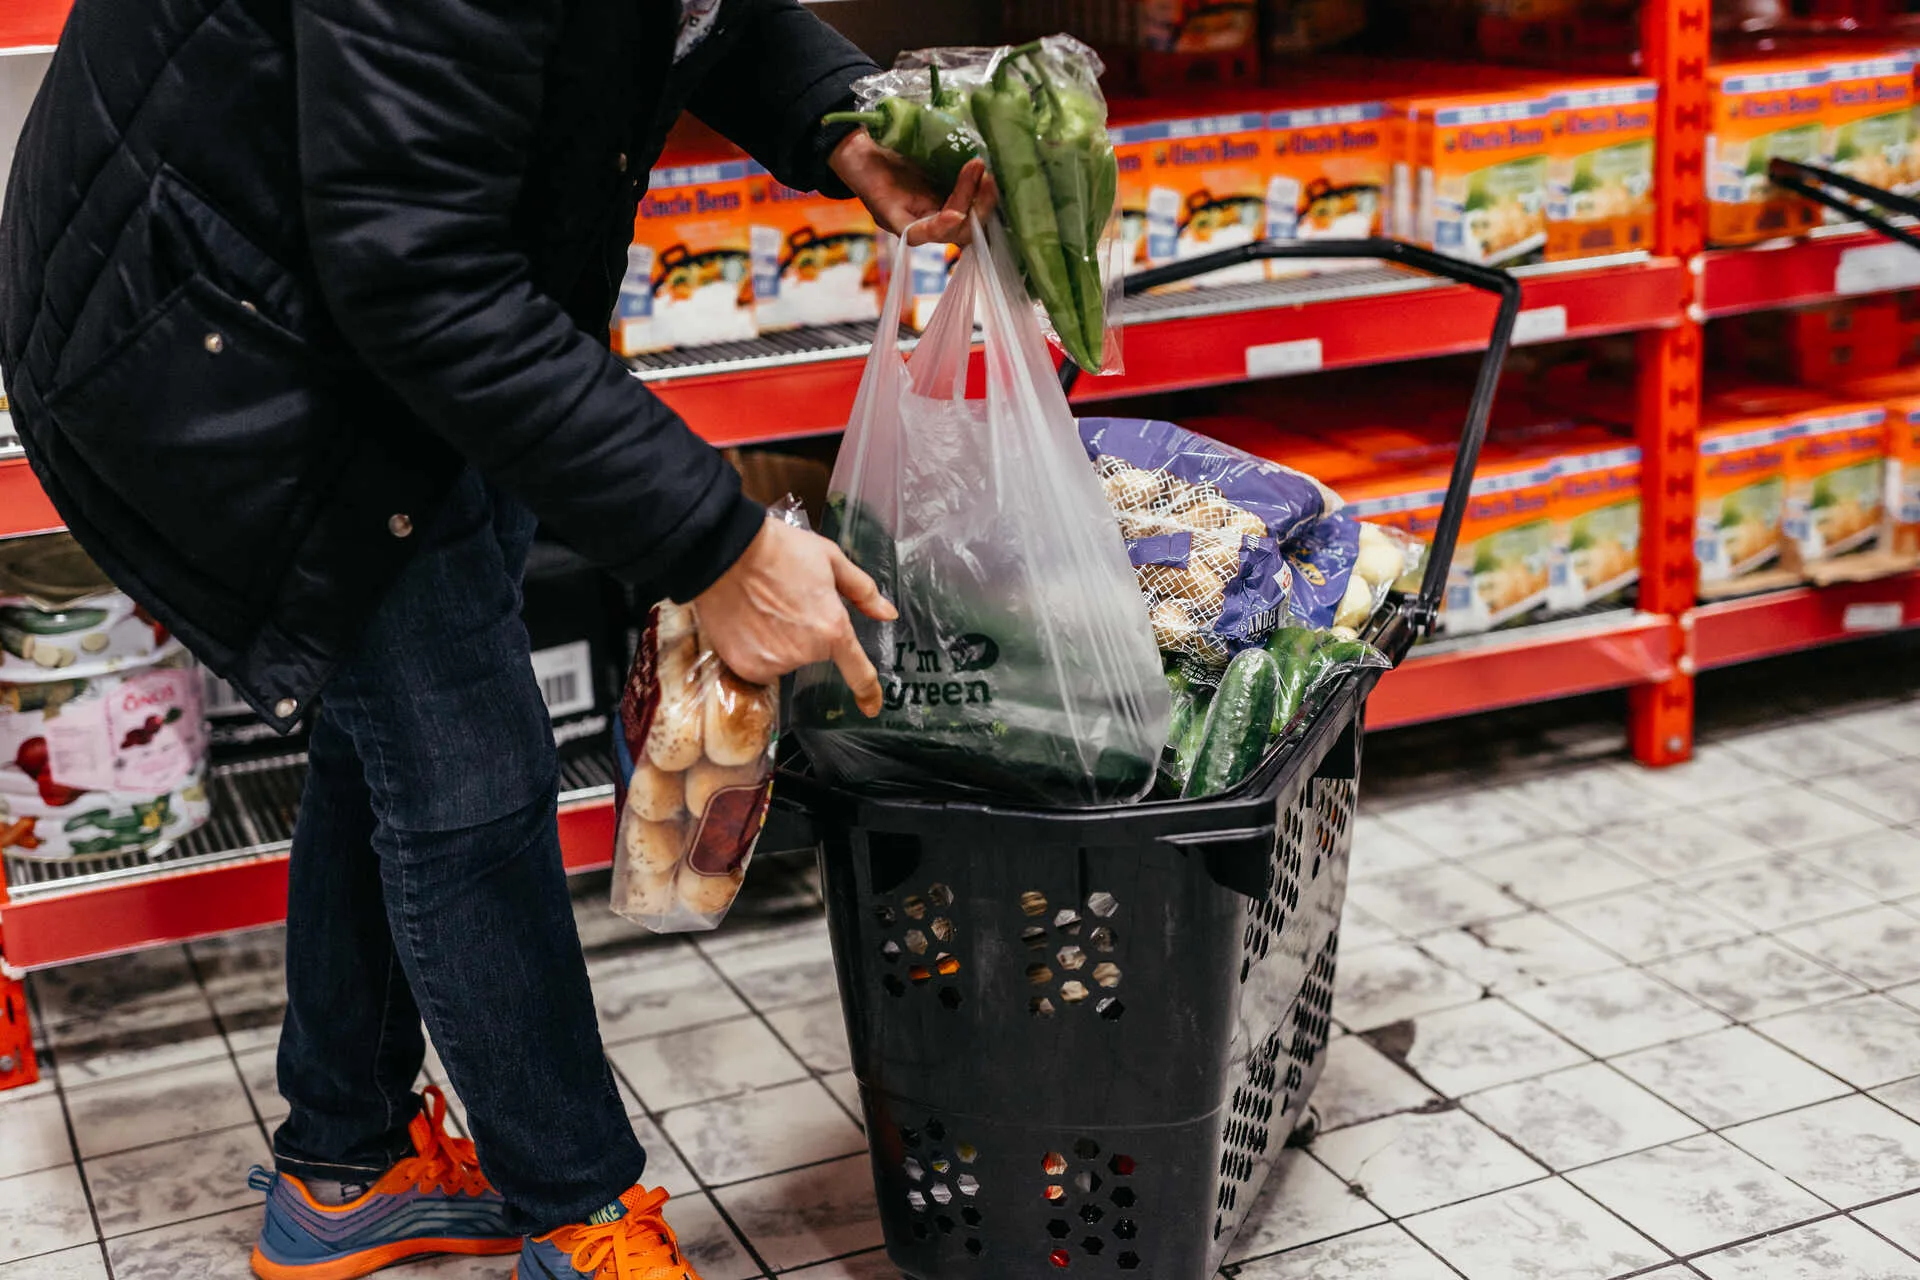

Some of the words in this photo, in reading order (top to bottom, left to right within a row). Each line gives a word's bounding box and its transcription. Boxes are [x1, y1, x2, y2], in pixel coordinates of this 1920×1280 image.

[893, 641, 942, 674] I'm
[883, 678, 993, 712] green
[589, 1203, 620, 1225] NIKE
